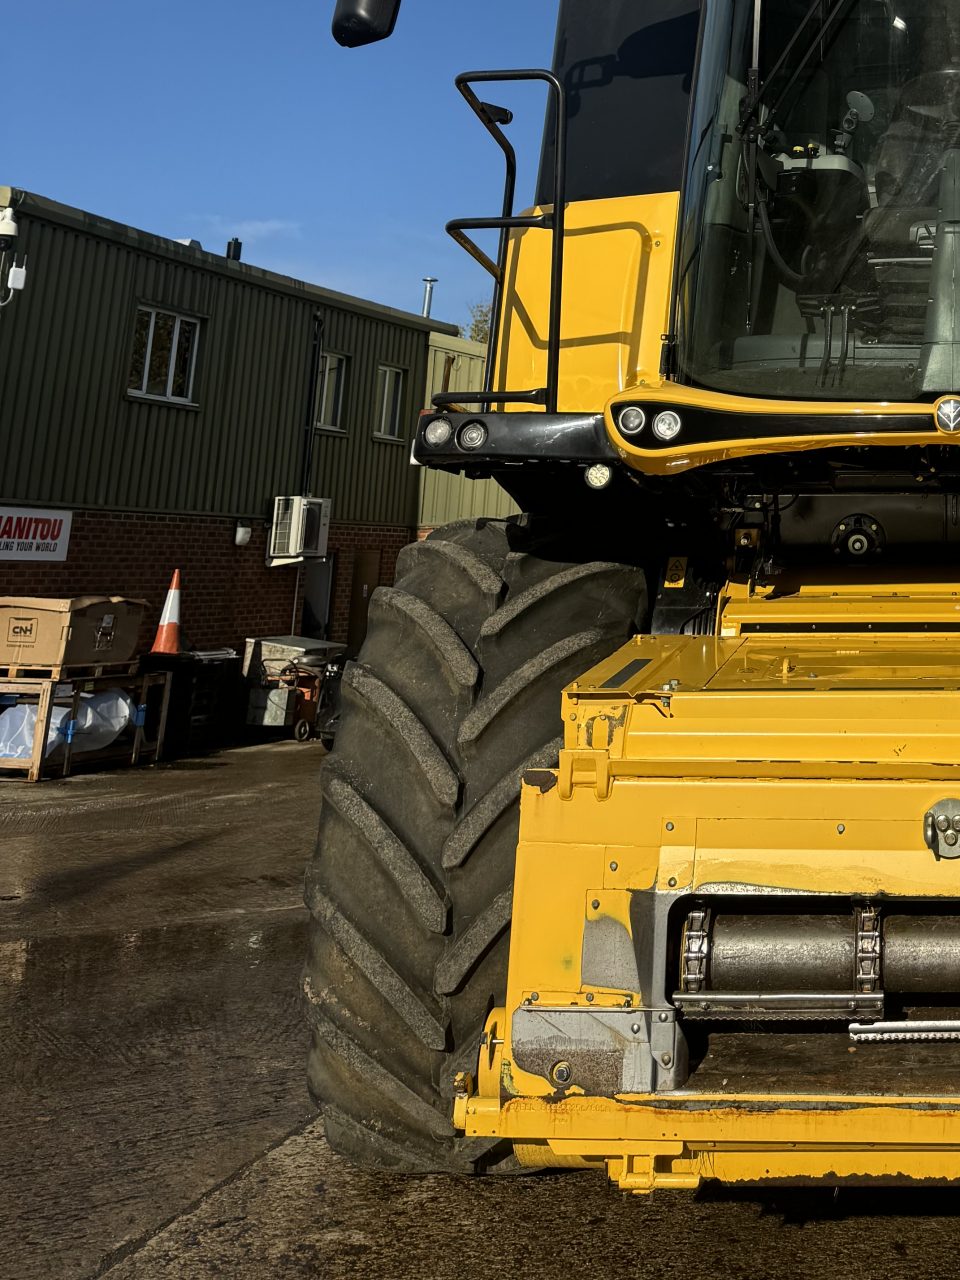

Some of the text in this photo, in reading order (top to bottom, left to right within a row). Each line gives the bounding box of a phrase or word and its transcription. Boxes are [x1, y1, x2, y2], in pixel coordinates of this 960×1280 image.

[0, 516, 64, 542] ANITOU
[16, 541, 33, 552] YOUR
[35, 542, 58, 553] WORLD
